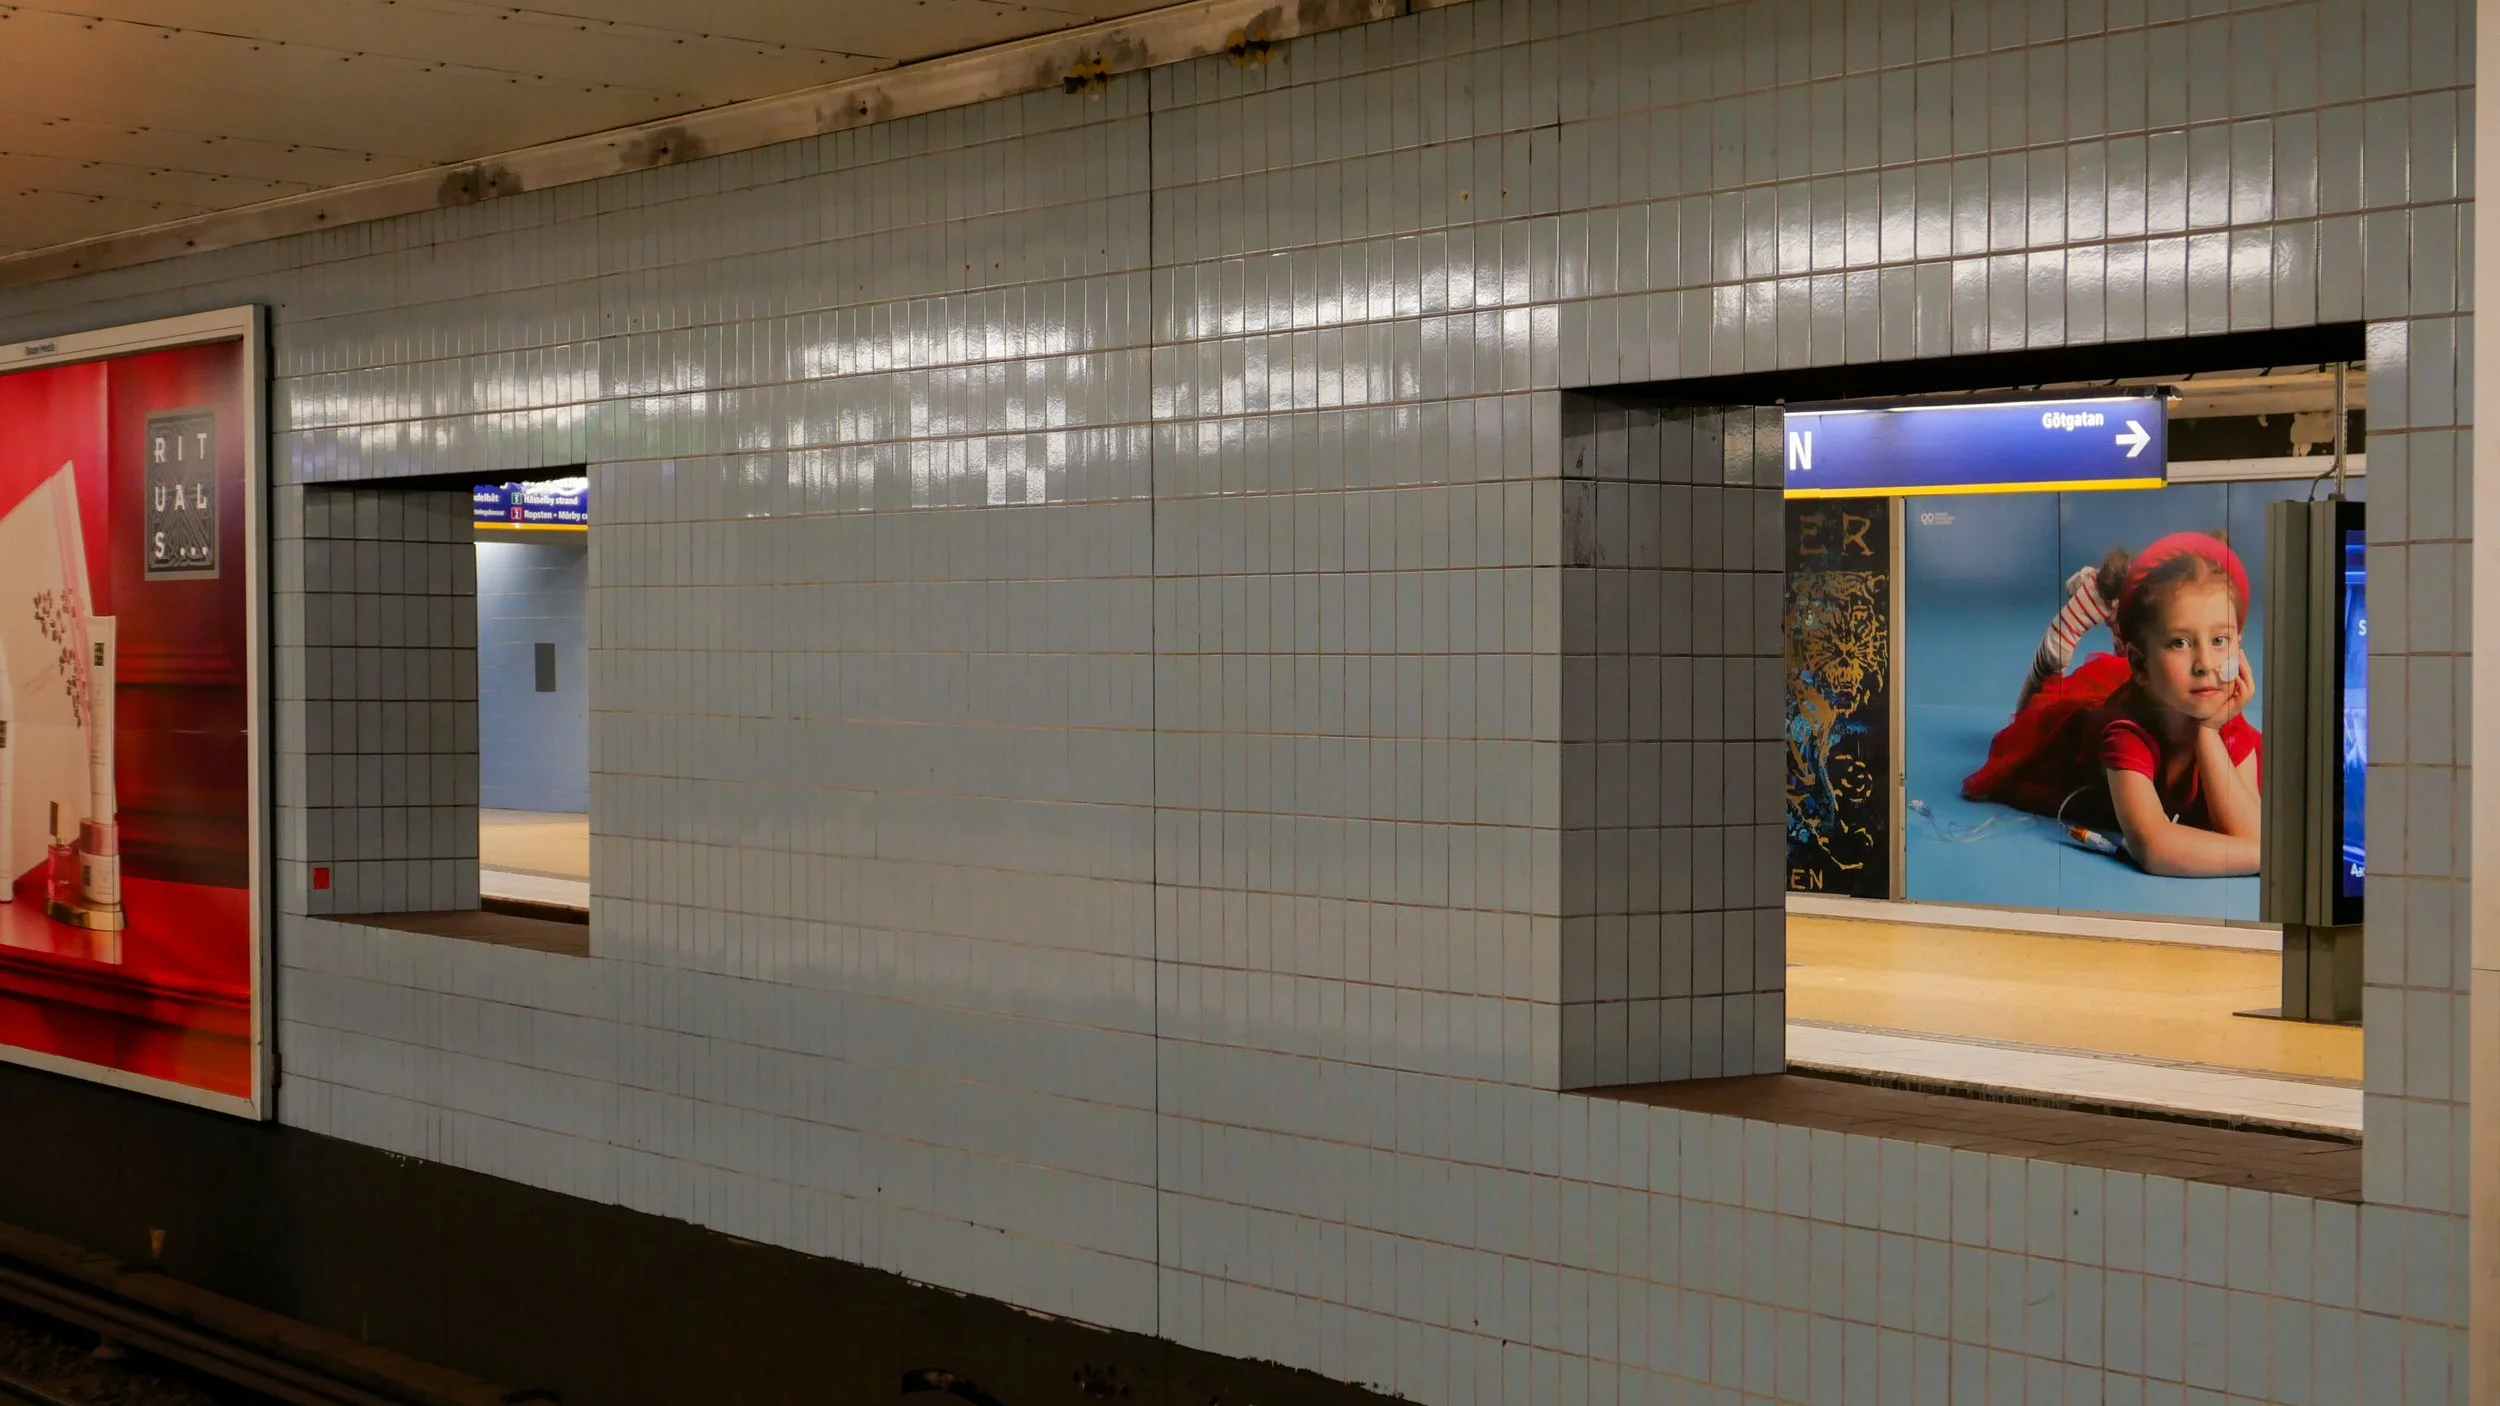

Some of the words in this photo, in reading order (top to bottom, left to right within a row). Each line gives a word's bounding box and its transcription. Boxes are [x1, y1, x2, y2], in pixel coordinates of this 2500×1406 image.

[2042, 411, 2104, 431] Götgatan
[1789, 431, 1812, 470] N
[555, 495, 578, 505] strand
[524, 510, 552, 520] Ropsten
[558, 511, 581, 522] Mörby
[1790, 867, 1824, 890] EN
